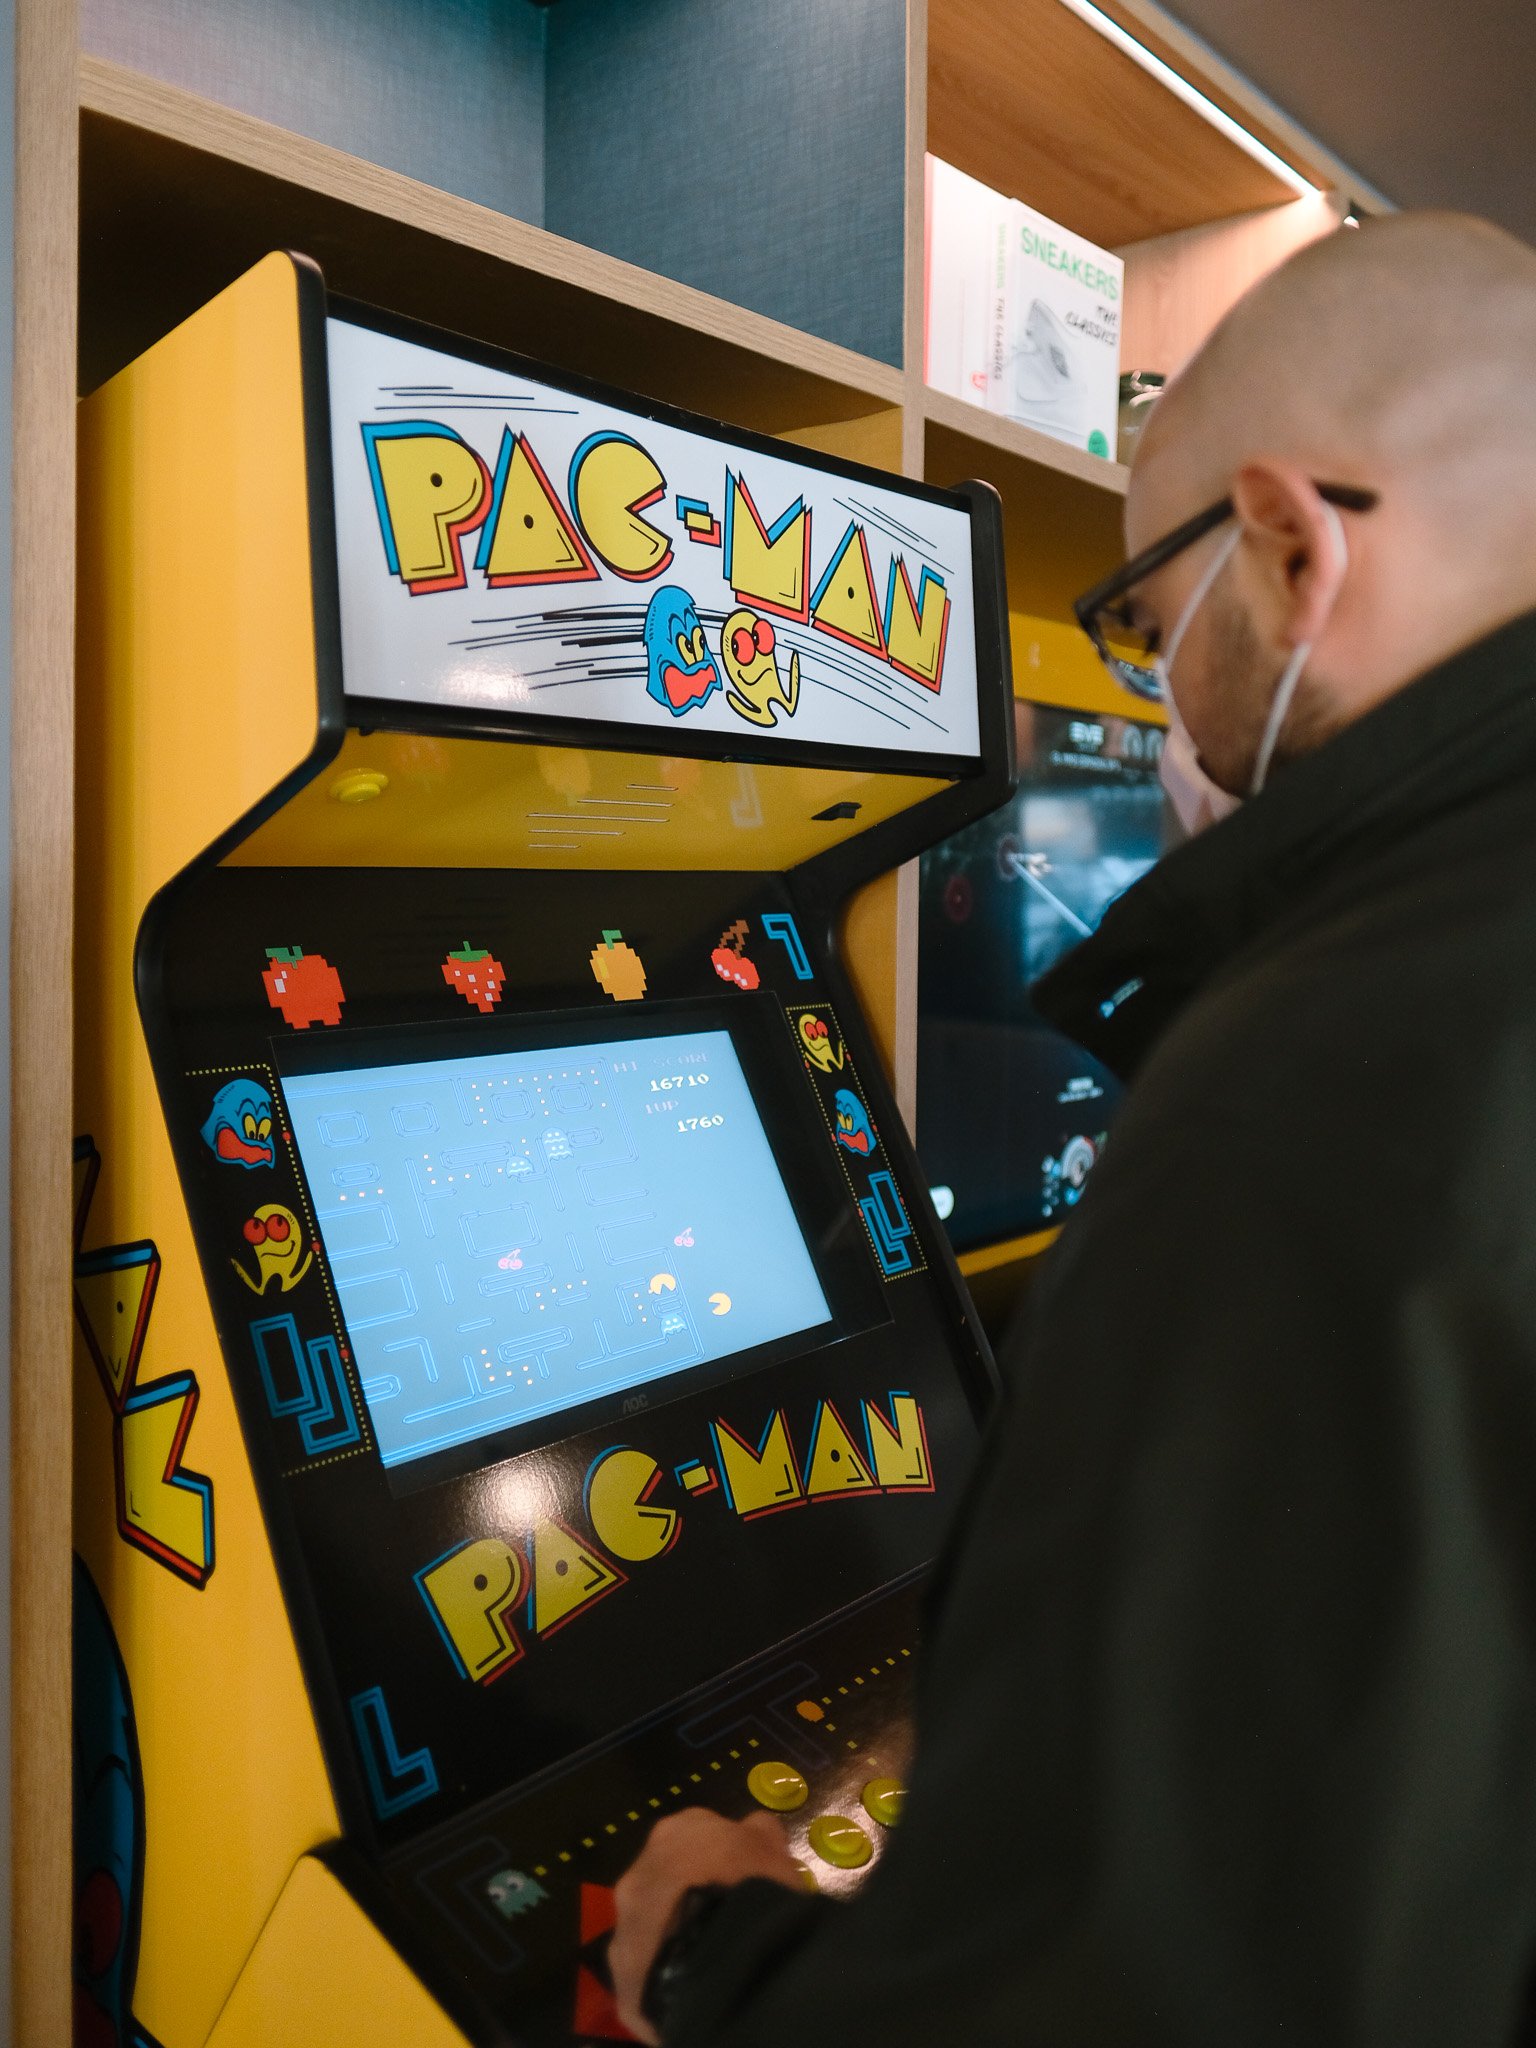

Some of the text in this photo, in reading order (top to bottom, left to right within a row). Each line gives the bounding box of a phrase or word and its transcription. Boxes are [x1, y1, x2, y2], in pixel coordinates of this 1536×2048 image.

[1020, 226, 1118, 301] SNEAKERS
[360, 419, 951, 694] PAC-MAN
[650, 1073, 710, 1092] 16710
[677, 1114, 724, 1133] 1760
[622, 1393, 649, 1415] AOC
[413, 1391, 936, 1687] PAC-MAN
